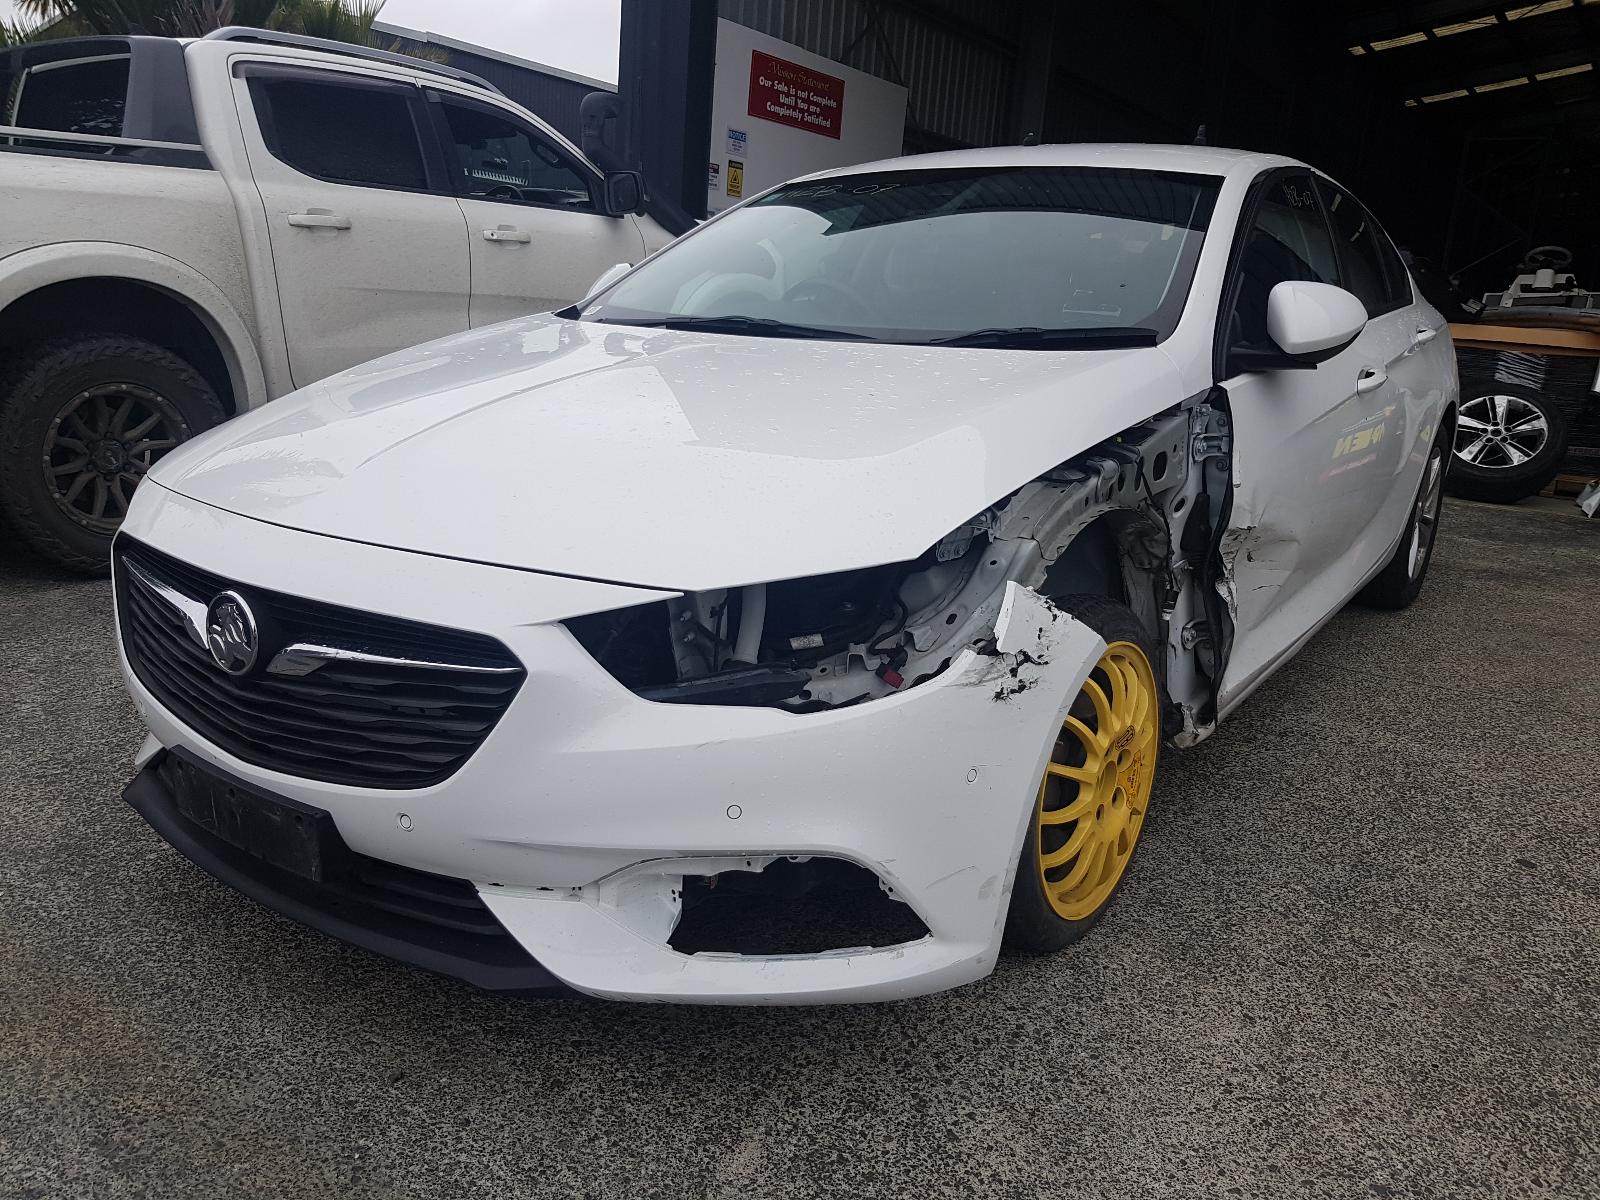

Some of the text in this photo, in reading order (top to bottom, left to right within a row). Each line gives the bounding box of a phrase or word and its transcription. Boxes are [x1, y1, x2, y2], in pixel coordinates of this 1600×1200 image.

[759, 76, 837, 108] Our Sale is not Complete
[779, 94, 821, 114] Until You are
[766, 101, 831, 128] Completely Satisfied
